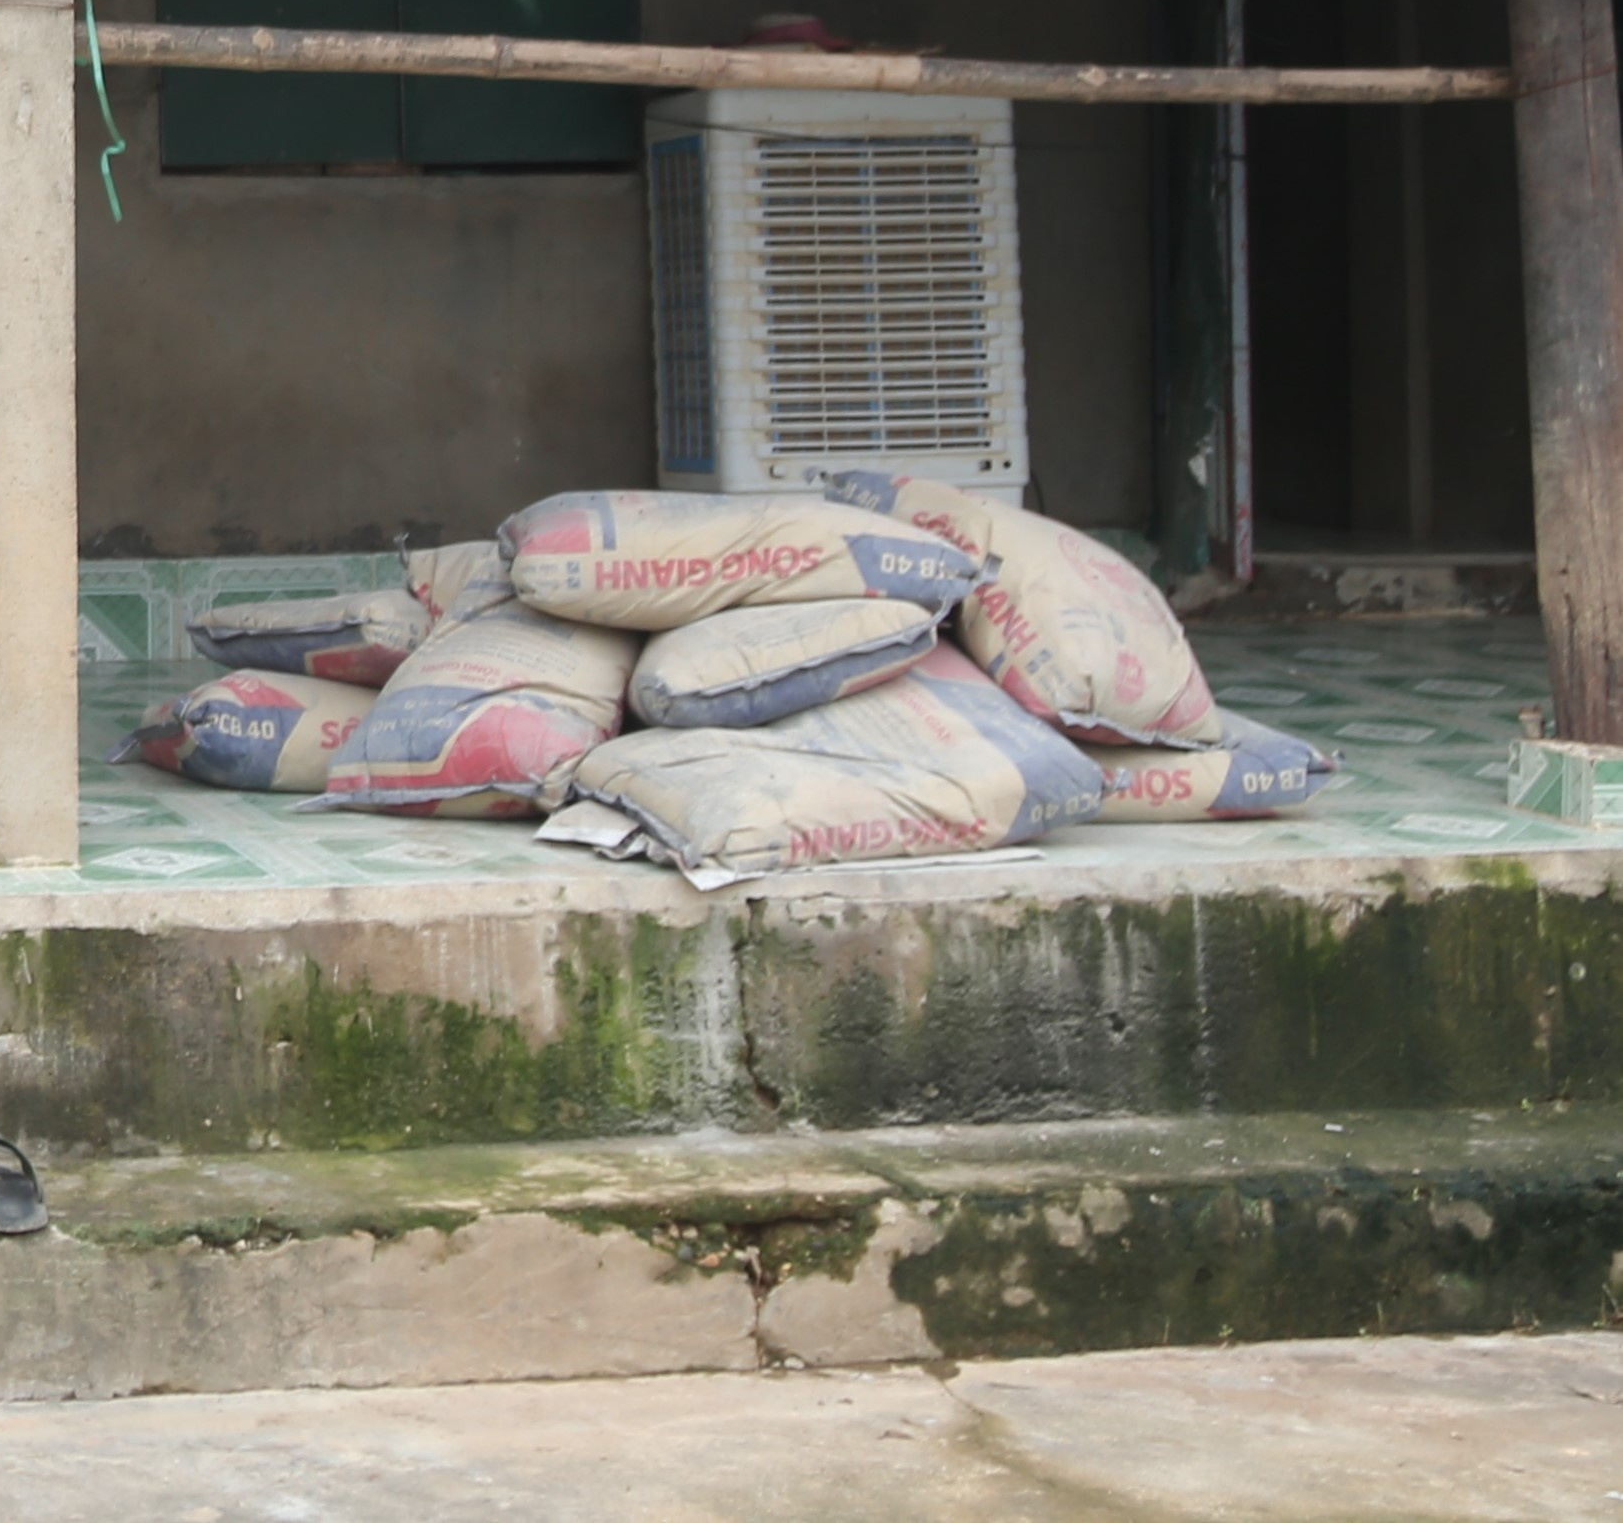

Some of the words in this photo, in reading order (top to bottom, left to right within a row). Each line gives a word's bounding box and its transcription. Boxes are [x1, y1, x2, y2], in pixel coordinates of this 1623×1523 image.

[721, 545, 824, 580] SÔNG
[880, 552, 913, 575] 40
[594, 557, 714, 592] GIANH
[247, 719, 276, 740] 40
[1242, 772, 1274, 794] 40
